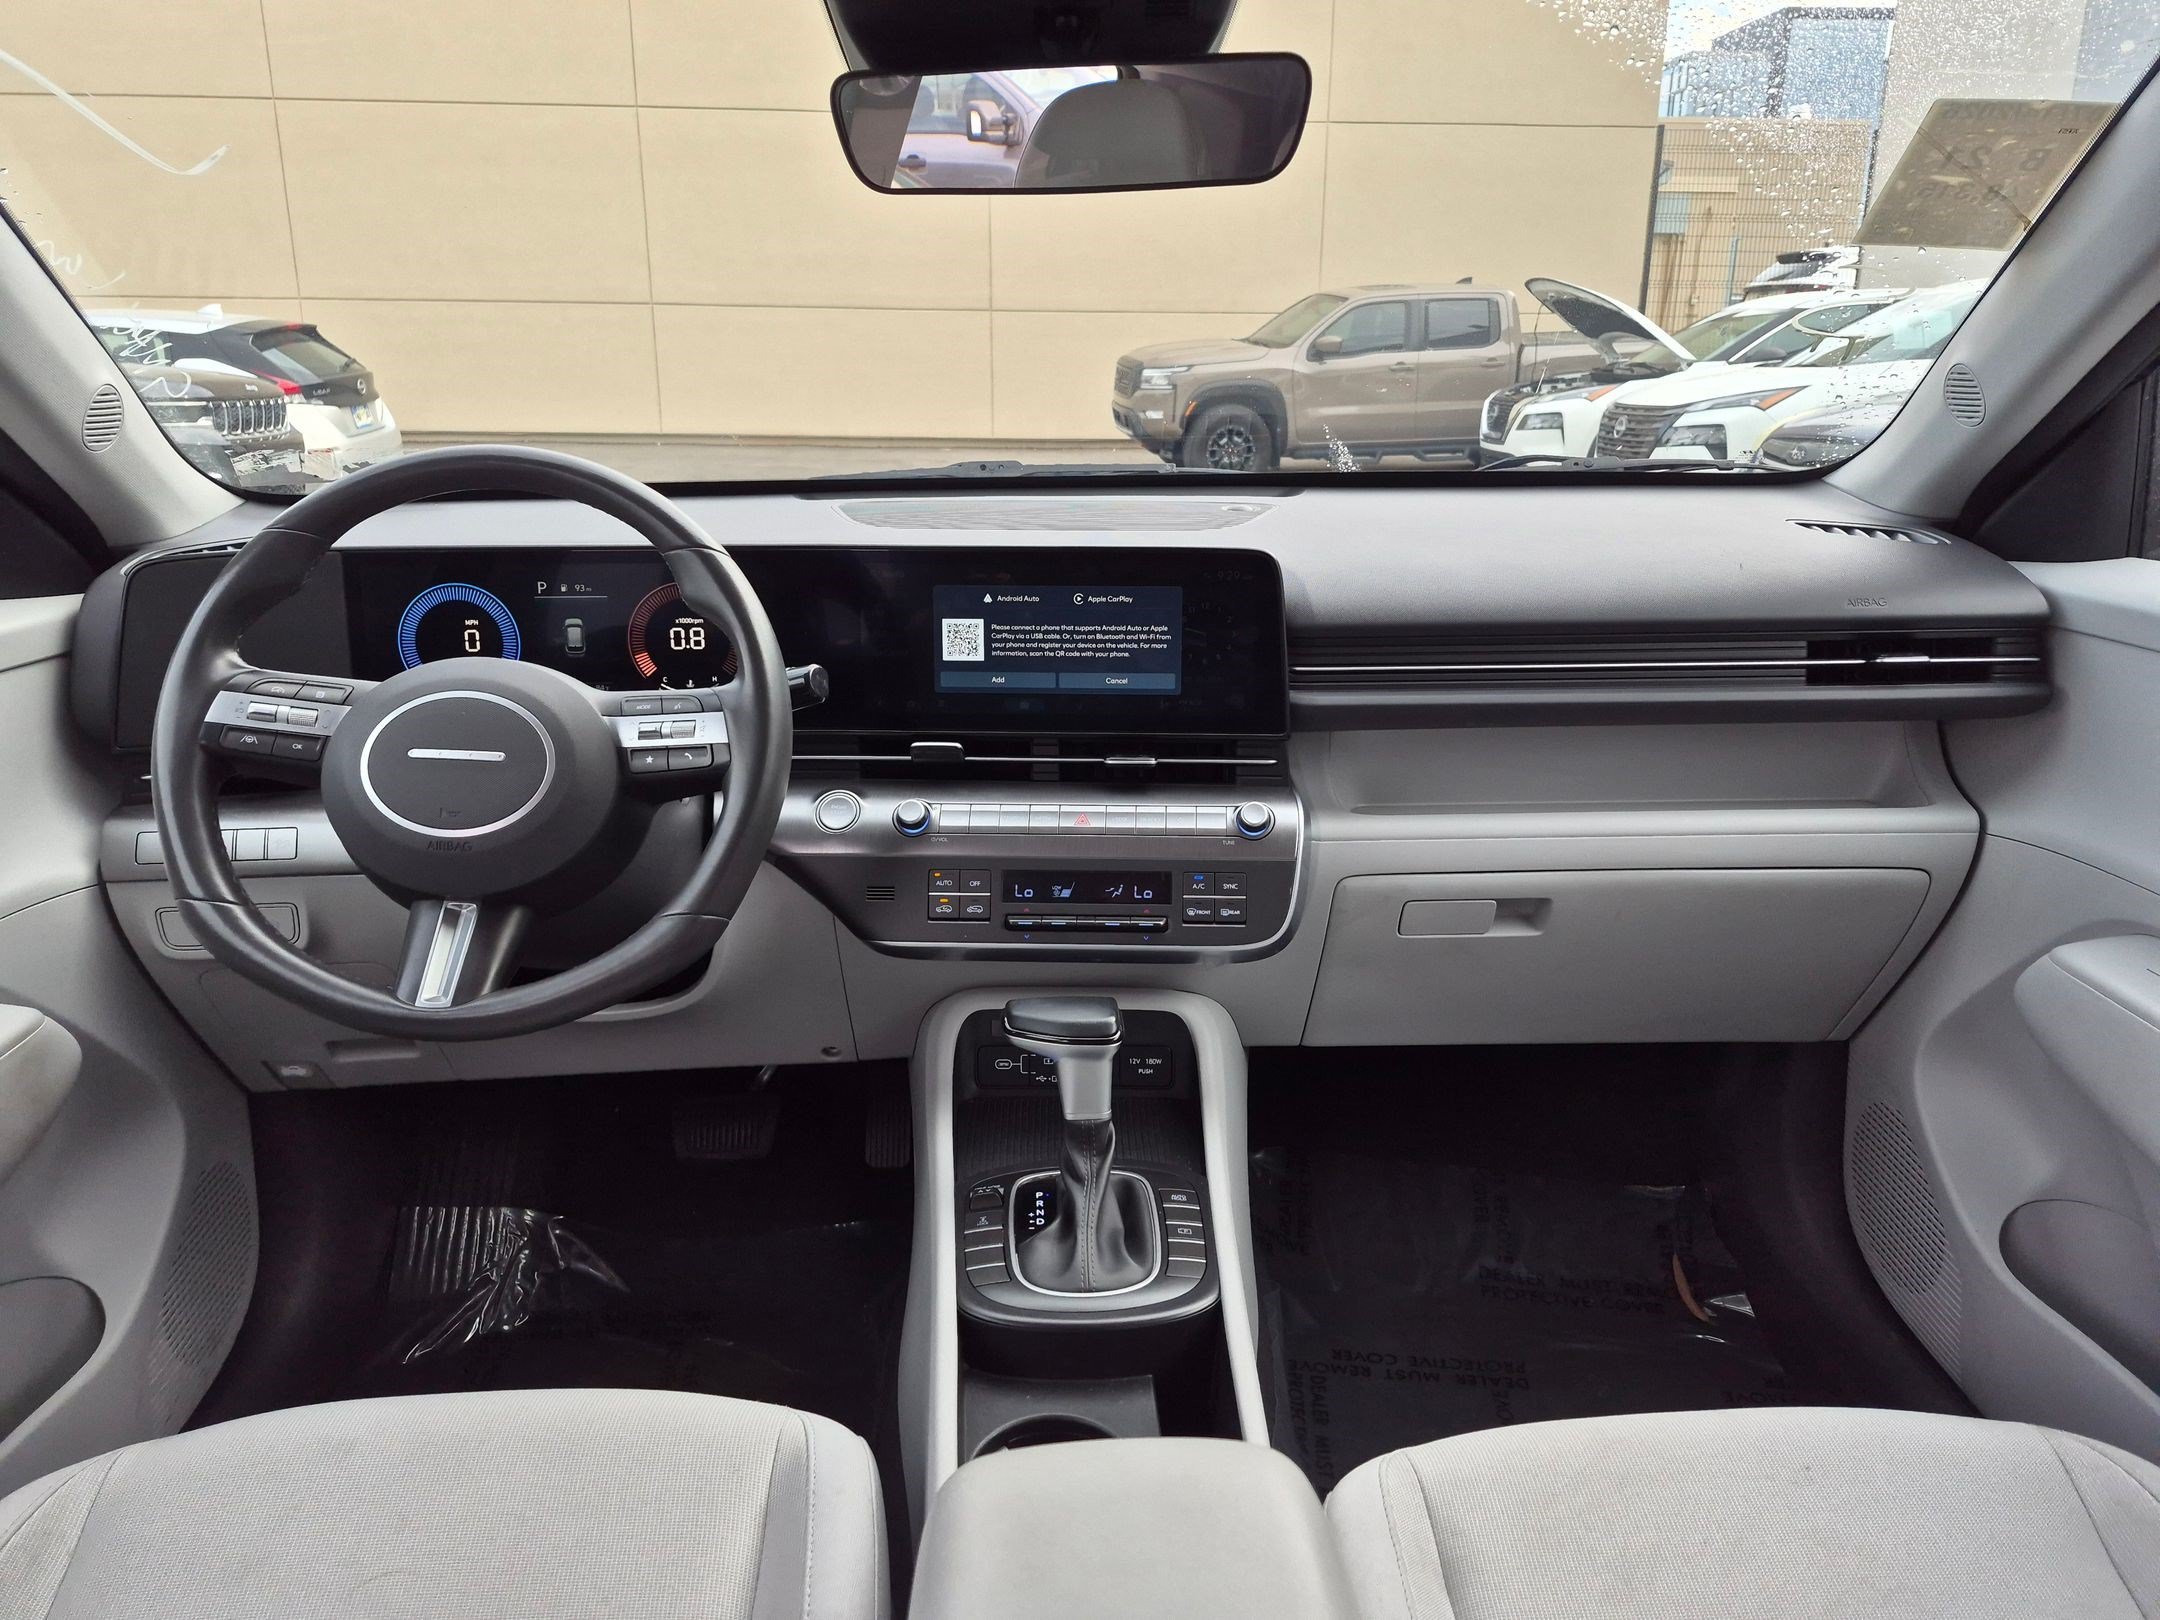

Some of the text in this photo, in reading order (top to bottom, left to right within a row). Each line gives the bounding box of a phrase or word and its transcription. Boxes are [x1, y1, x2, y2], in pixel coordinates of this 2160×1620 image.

[537, 581, 547, 594] P
[574, 584, 585, 592] 93
[1087, 595, 1133, 604] Apple CarPlay
[1847, 597, 1888, 607] AIRBAG
[675, 617, 704, 625] x1000rpm
[1041, 624, 1060, 632] phone
[1075, 625, 1101, 633] supports
[1151, 625, 1168, 633] Apple
[464, 629, 480, 652] 0
[669, 627, 705, 650] 0.8
[991, 633, 1015, 641] CarPlay
[1062, 633, 1072, 641] Or,
[1006, 642, 1025, 650] phone
[1038, 642, 1061, 650] register
[992, 650, 1028, 658] information,
[1110, 651, 1130, 659] phone.
[991, 676, 1005, 684] Add
[1105, 677, 1128, 685] Cancel
[425, 840, 472, 851] AIRBAG
[1014, 884, 1034, 898] Lo
[1134, 885, 1153, 899] Lo
[1036, 1191, 1044, 1199] P
